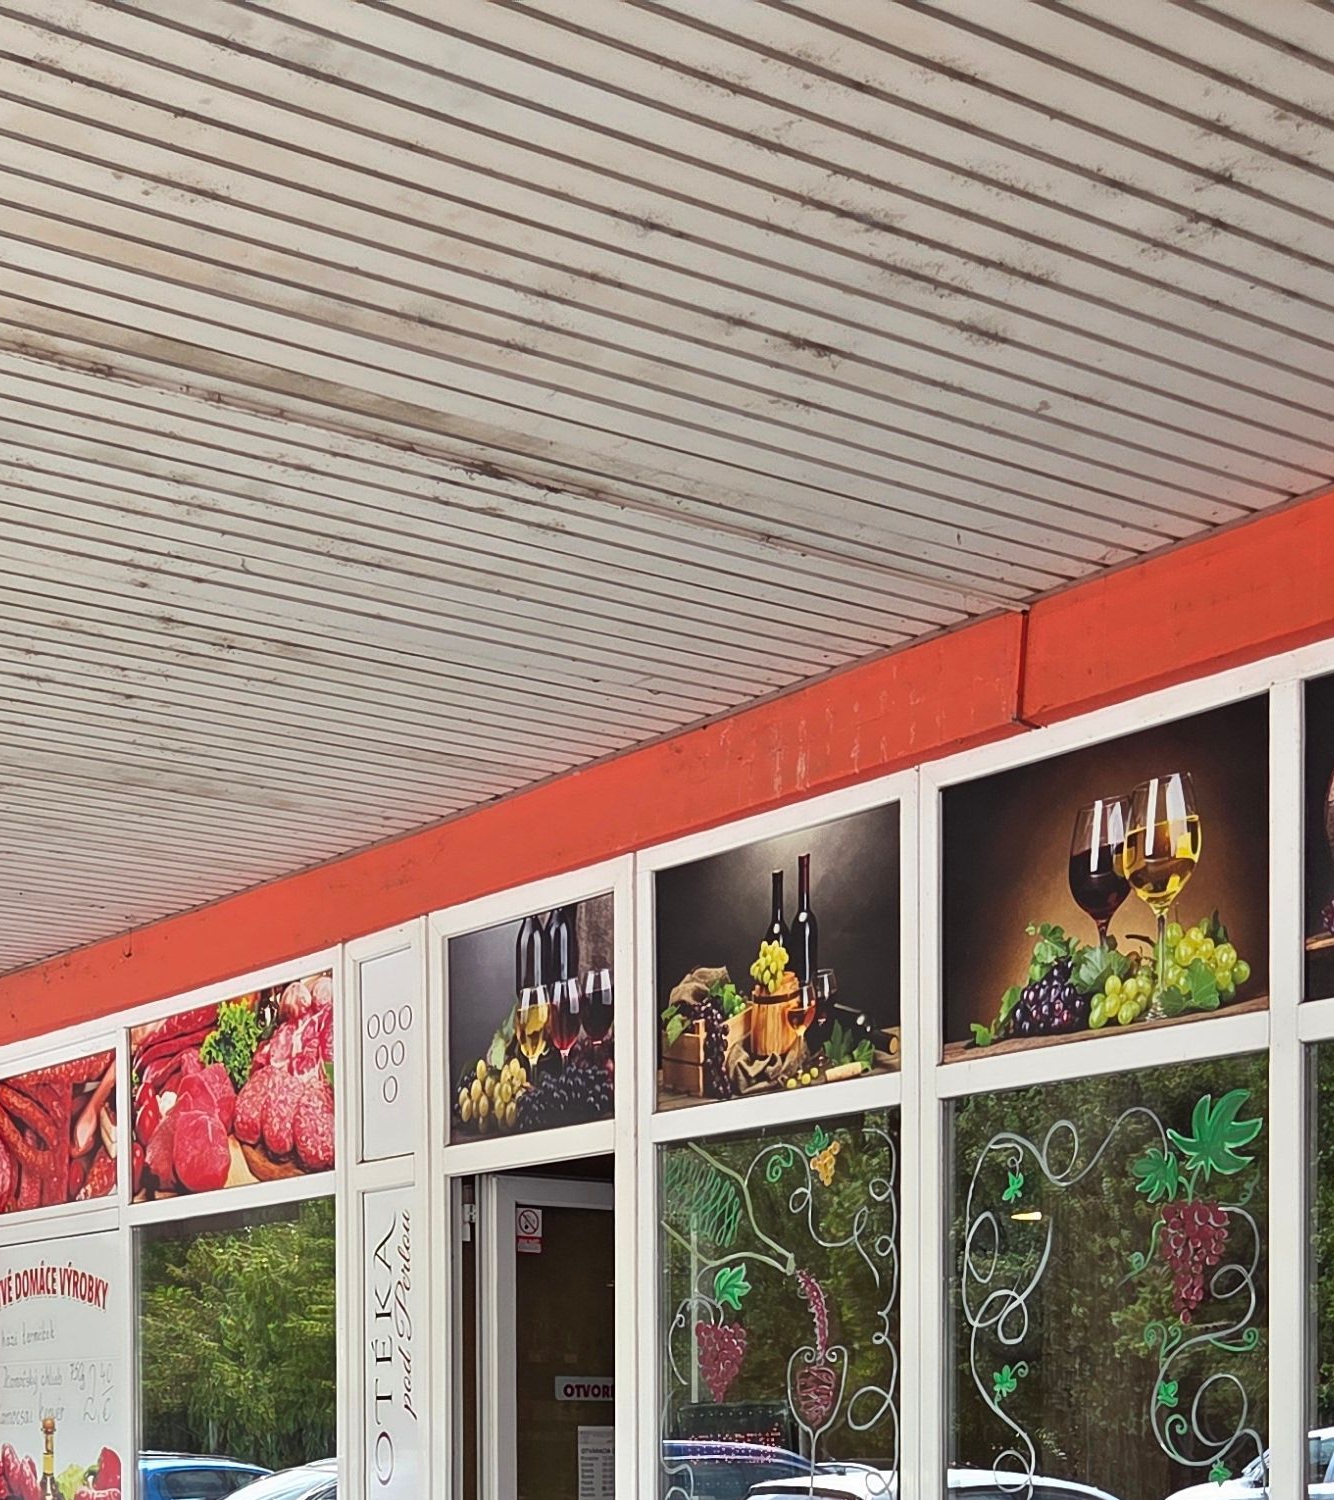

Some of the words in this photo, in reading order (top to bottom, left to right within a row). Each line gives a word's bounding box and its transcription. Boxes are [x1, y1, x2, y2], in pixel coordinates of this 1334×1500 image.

[14, 1260, 57, 1300] DOMÁCE
[58, 1261, 108, 1310] VÝROBKY
[394, 1209, 413, 1341] Perlou
[398, 1345, 417, 1420] pod
